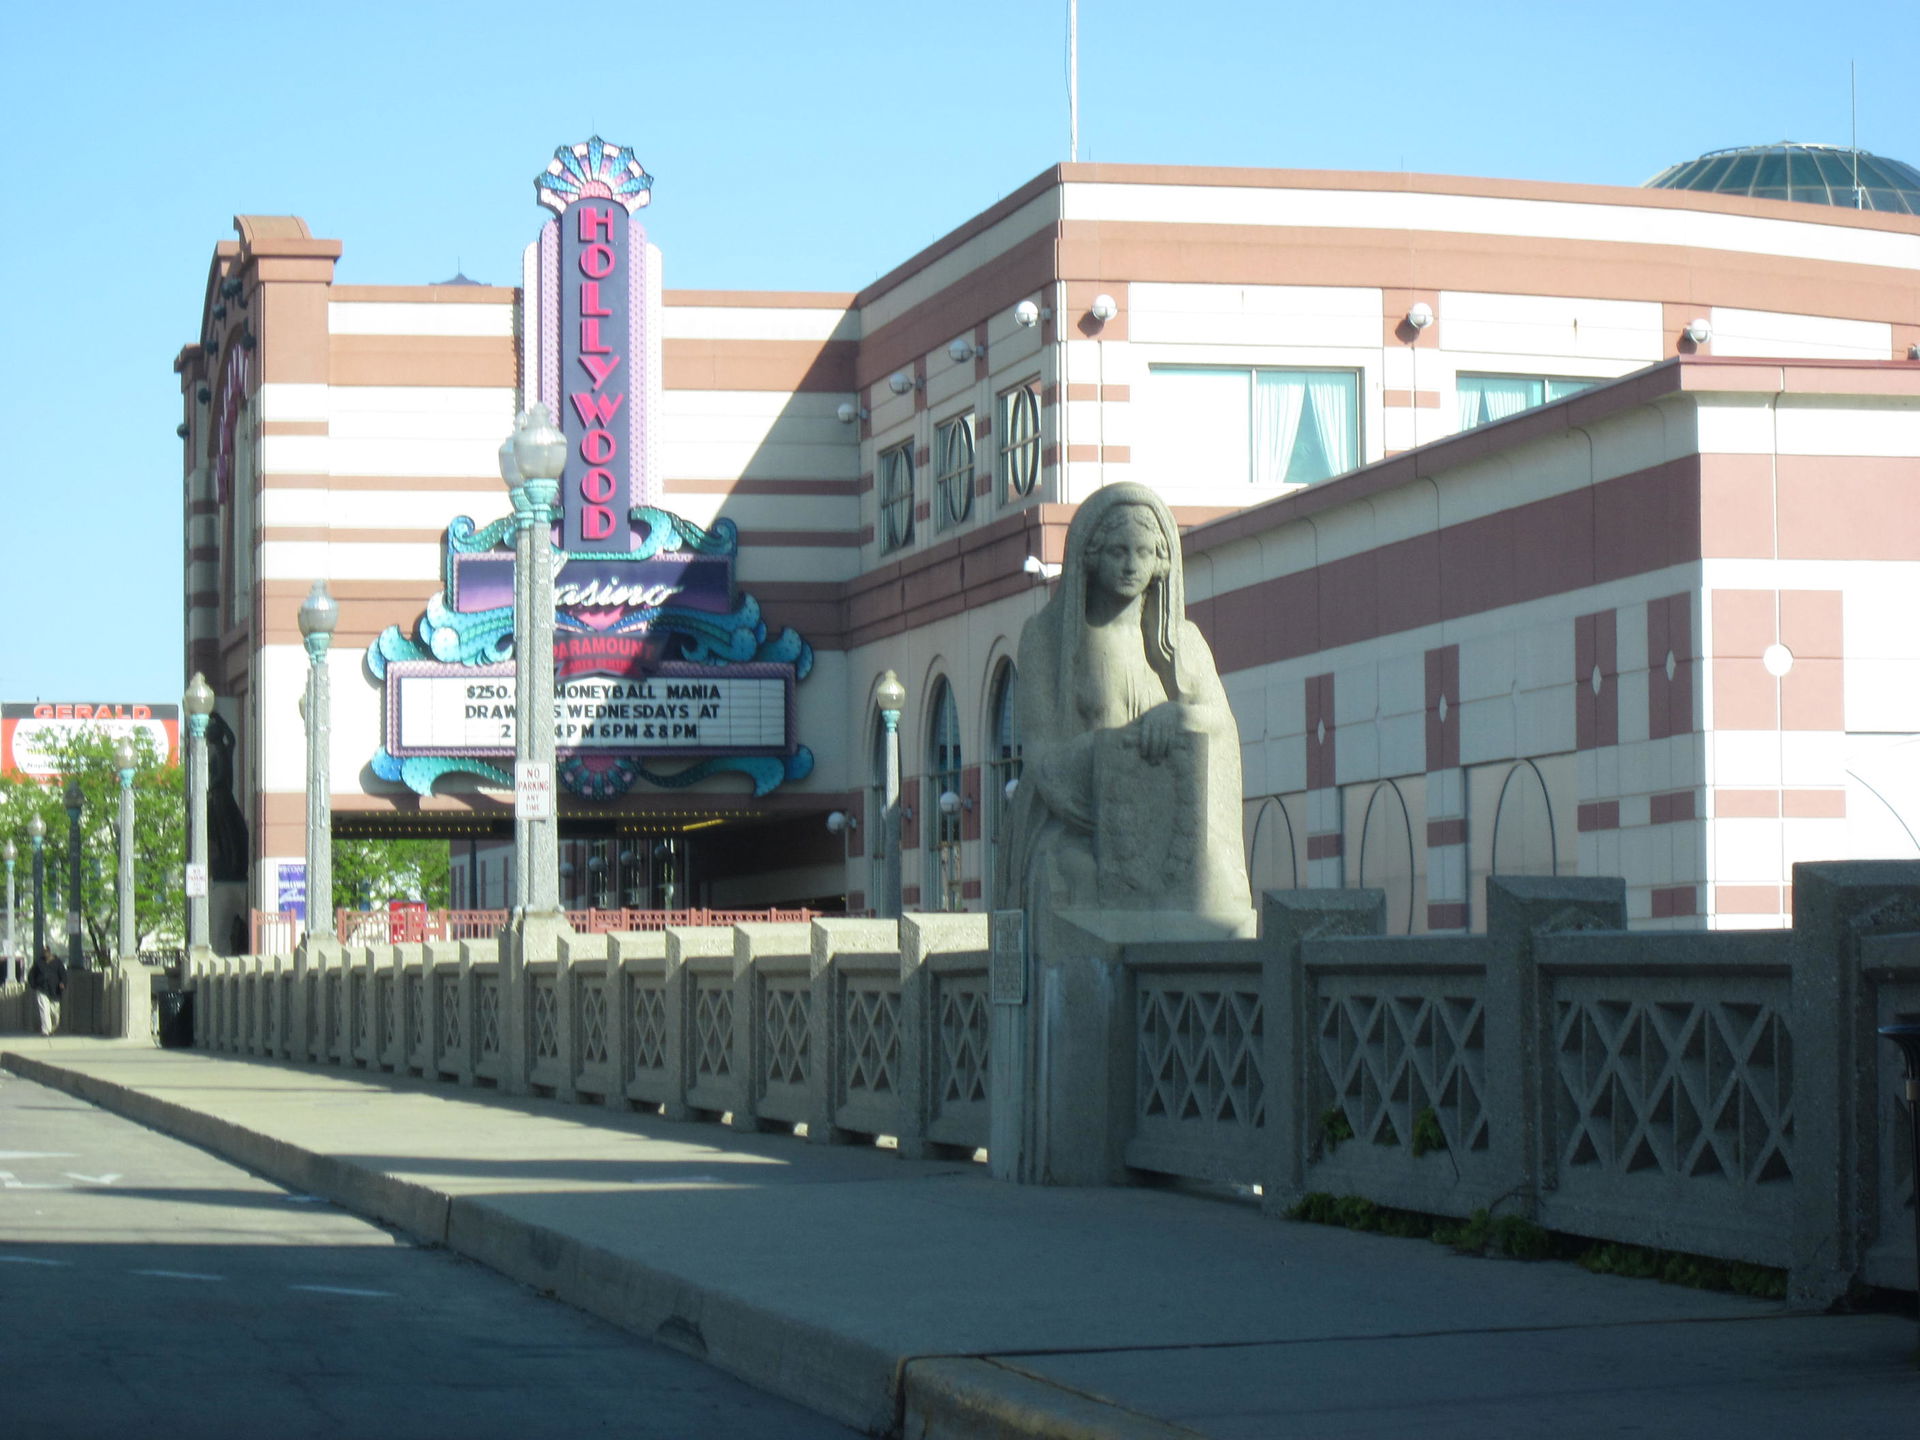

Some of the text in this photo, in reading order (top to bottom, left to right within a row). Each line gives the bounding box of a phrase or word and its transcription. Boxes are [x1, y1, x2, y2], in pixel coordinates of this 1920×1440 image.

[570, 207, 624, 540] HOLLYWOOD
[554, 684, 656, 699] MONEYBALL
[667, 685, 721, 699] MANIA
[34, 704, 152, 719] GERALD
[567, 704, 689, 719] WEDNESDAYS
[700, 704, 720, 719] AT
[600, 724, 638, 738] 6PM
[659, 724, 697, 738] 8PM
[527, 768, 540, 779] NO
[518, 781, 549, 791] PARKING
